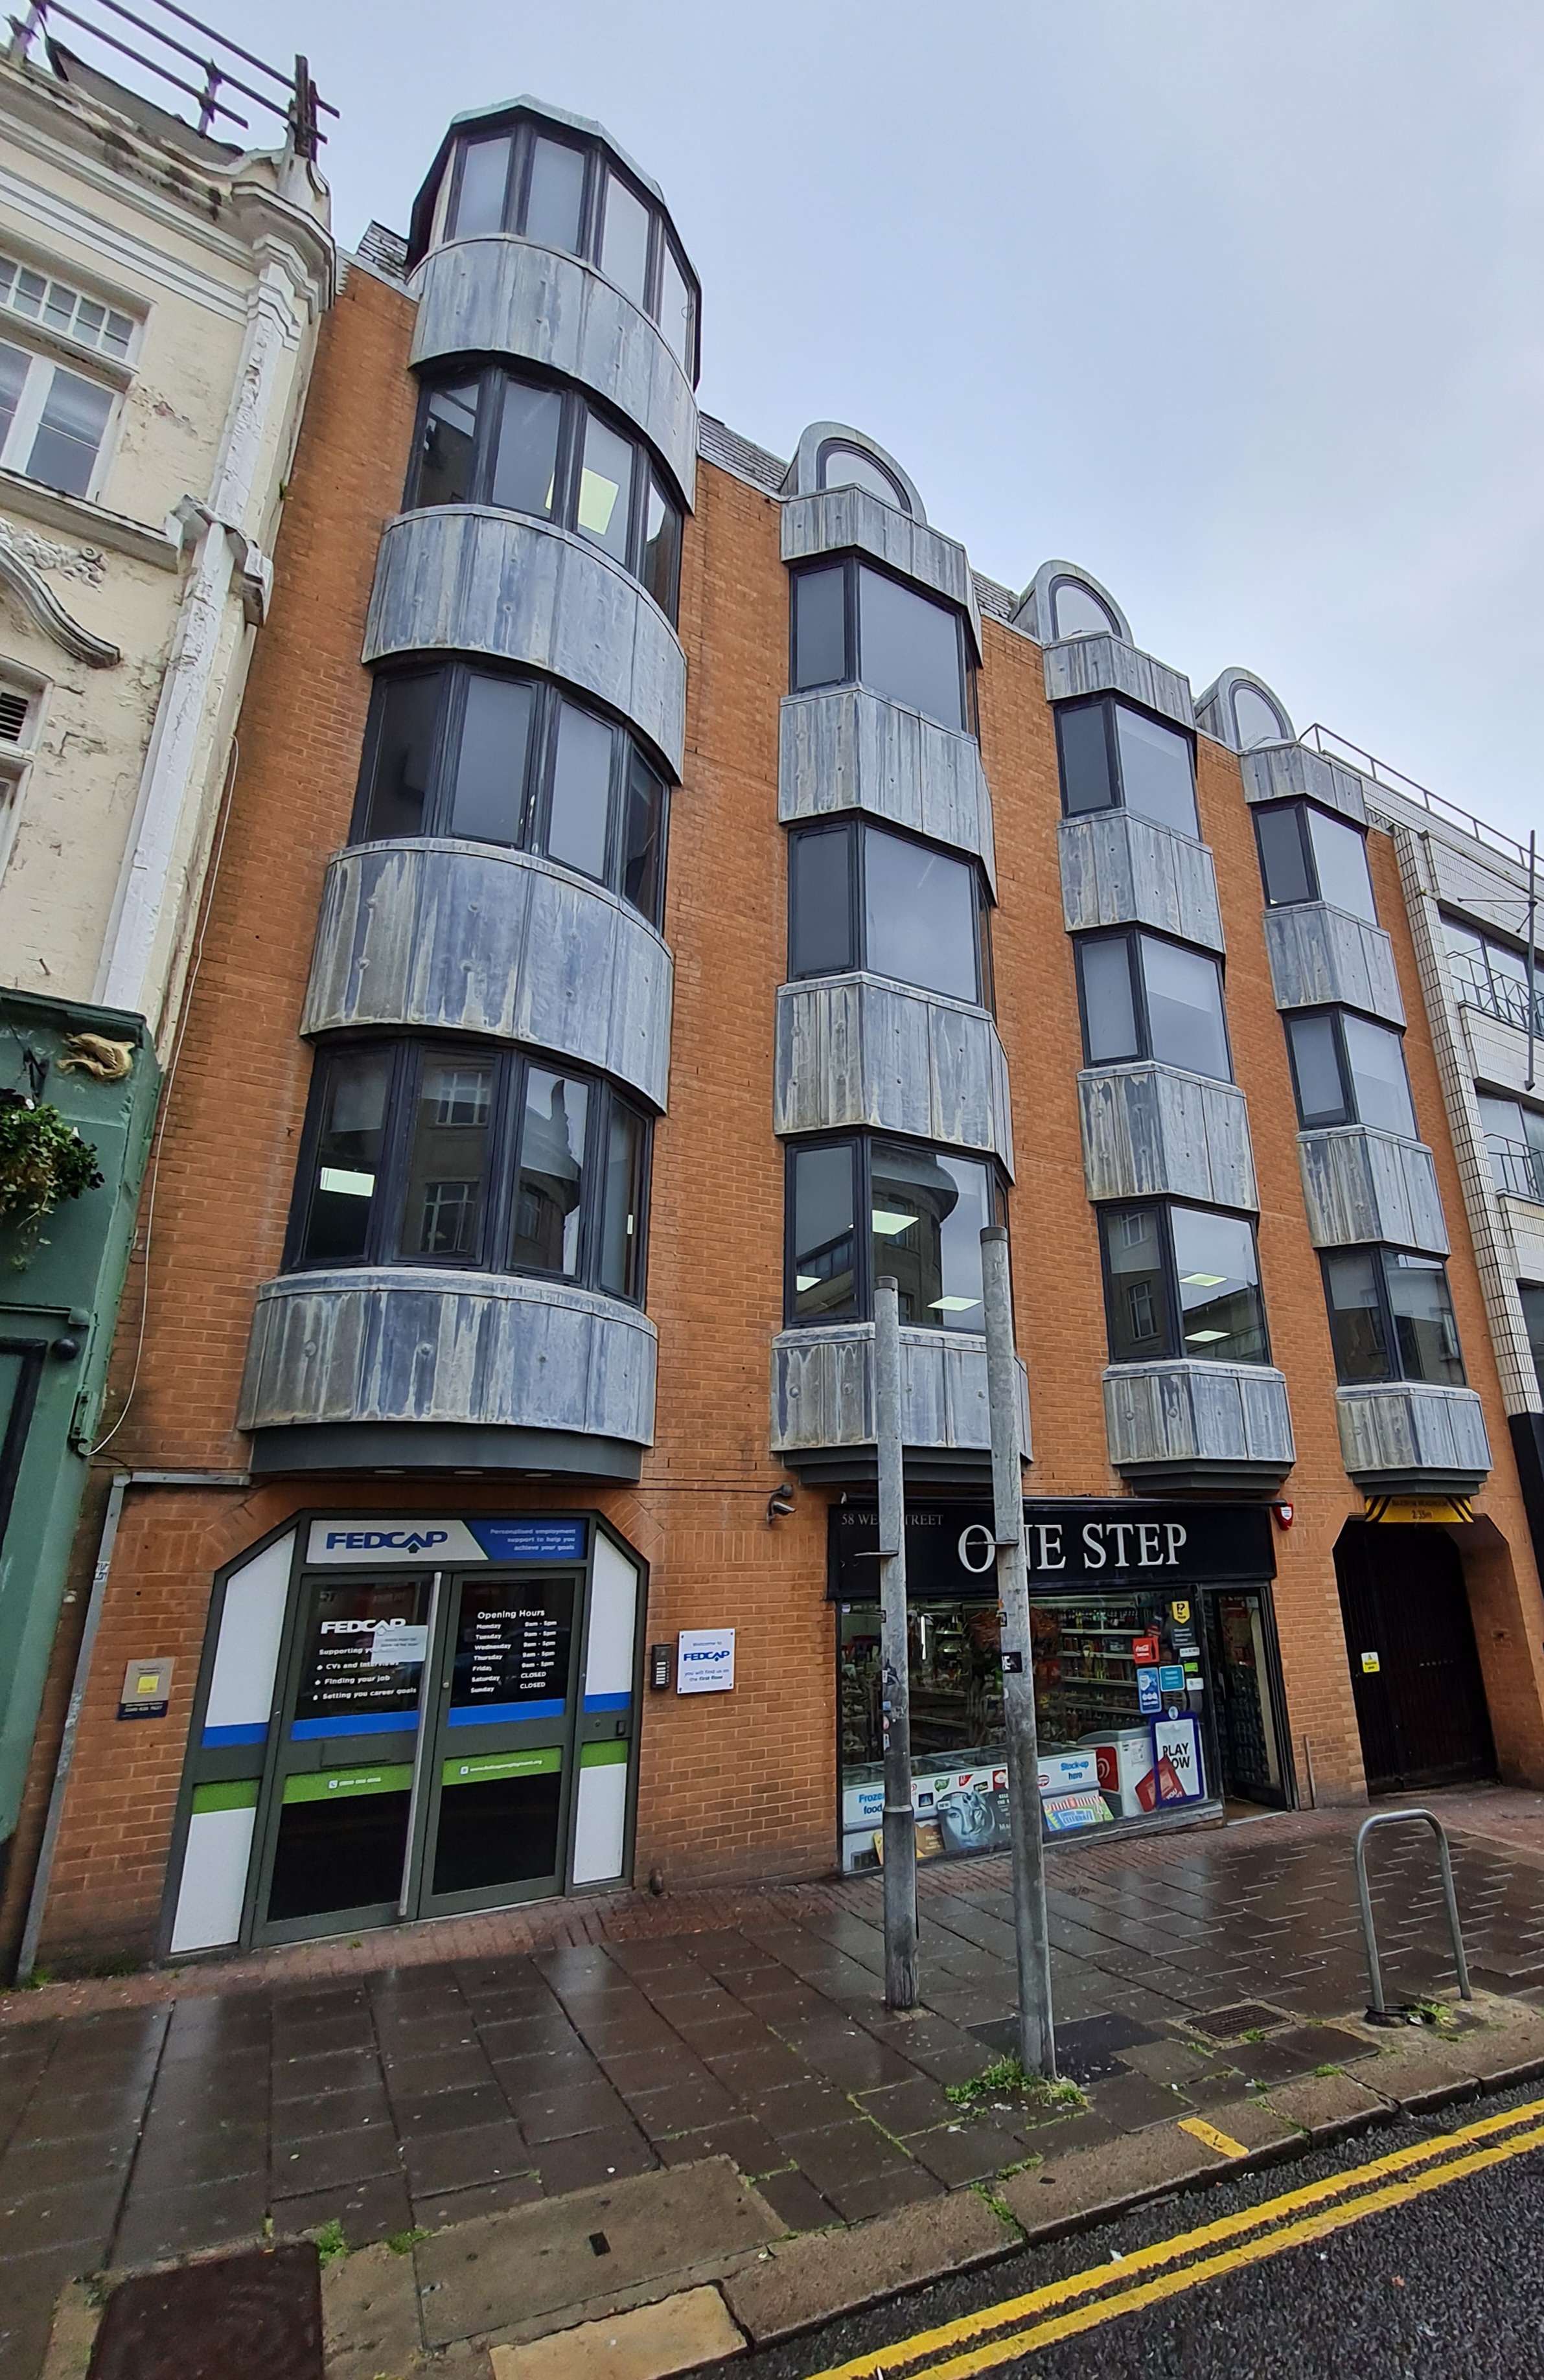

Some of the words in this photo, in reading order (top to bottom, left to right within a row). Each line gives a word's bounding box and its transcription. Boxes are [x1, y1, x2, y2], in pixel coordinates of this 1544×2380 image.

[841, 1514, 855, 1526] 58
[905, 1514, 944, 1526] TREET
[327, 1531, 448, 1551] FEDCAP
[958, 1524, 1066, 1573] OE
[1081, 1523, 1187, 1569] STEP
[477, 1610, 516, 1619] Opening
[321, 1618, 406, 1634] FEDCAP
[319, 1647, 363, 1656] Supporting
[684, 1651, 730, 1662] FEDCAP
[376, 1675, 391, 1683] job
[1163, 1743, 1188, 1757] PLAY
[1061, 1761, 1089, 1771] Stock-up
[1171, 1756, 1190, 1770] OW
[864, 1803, 882, 1814] food
